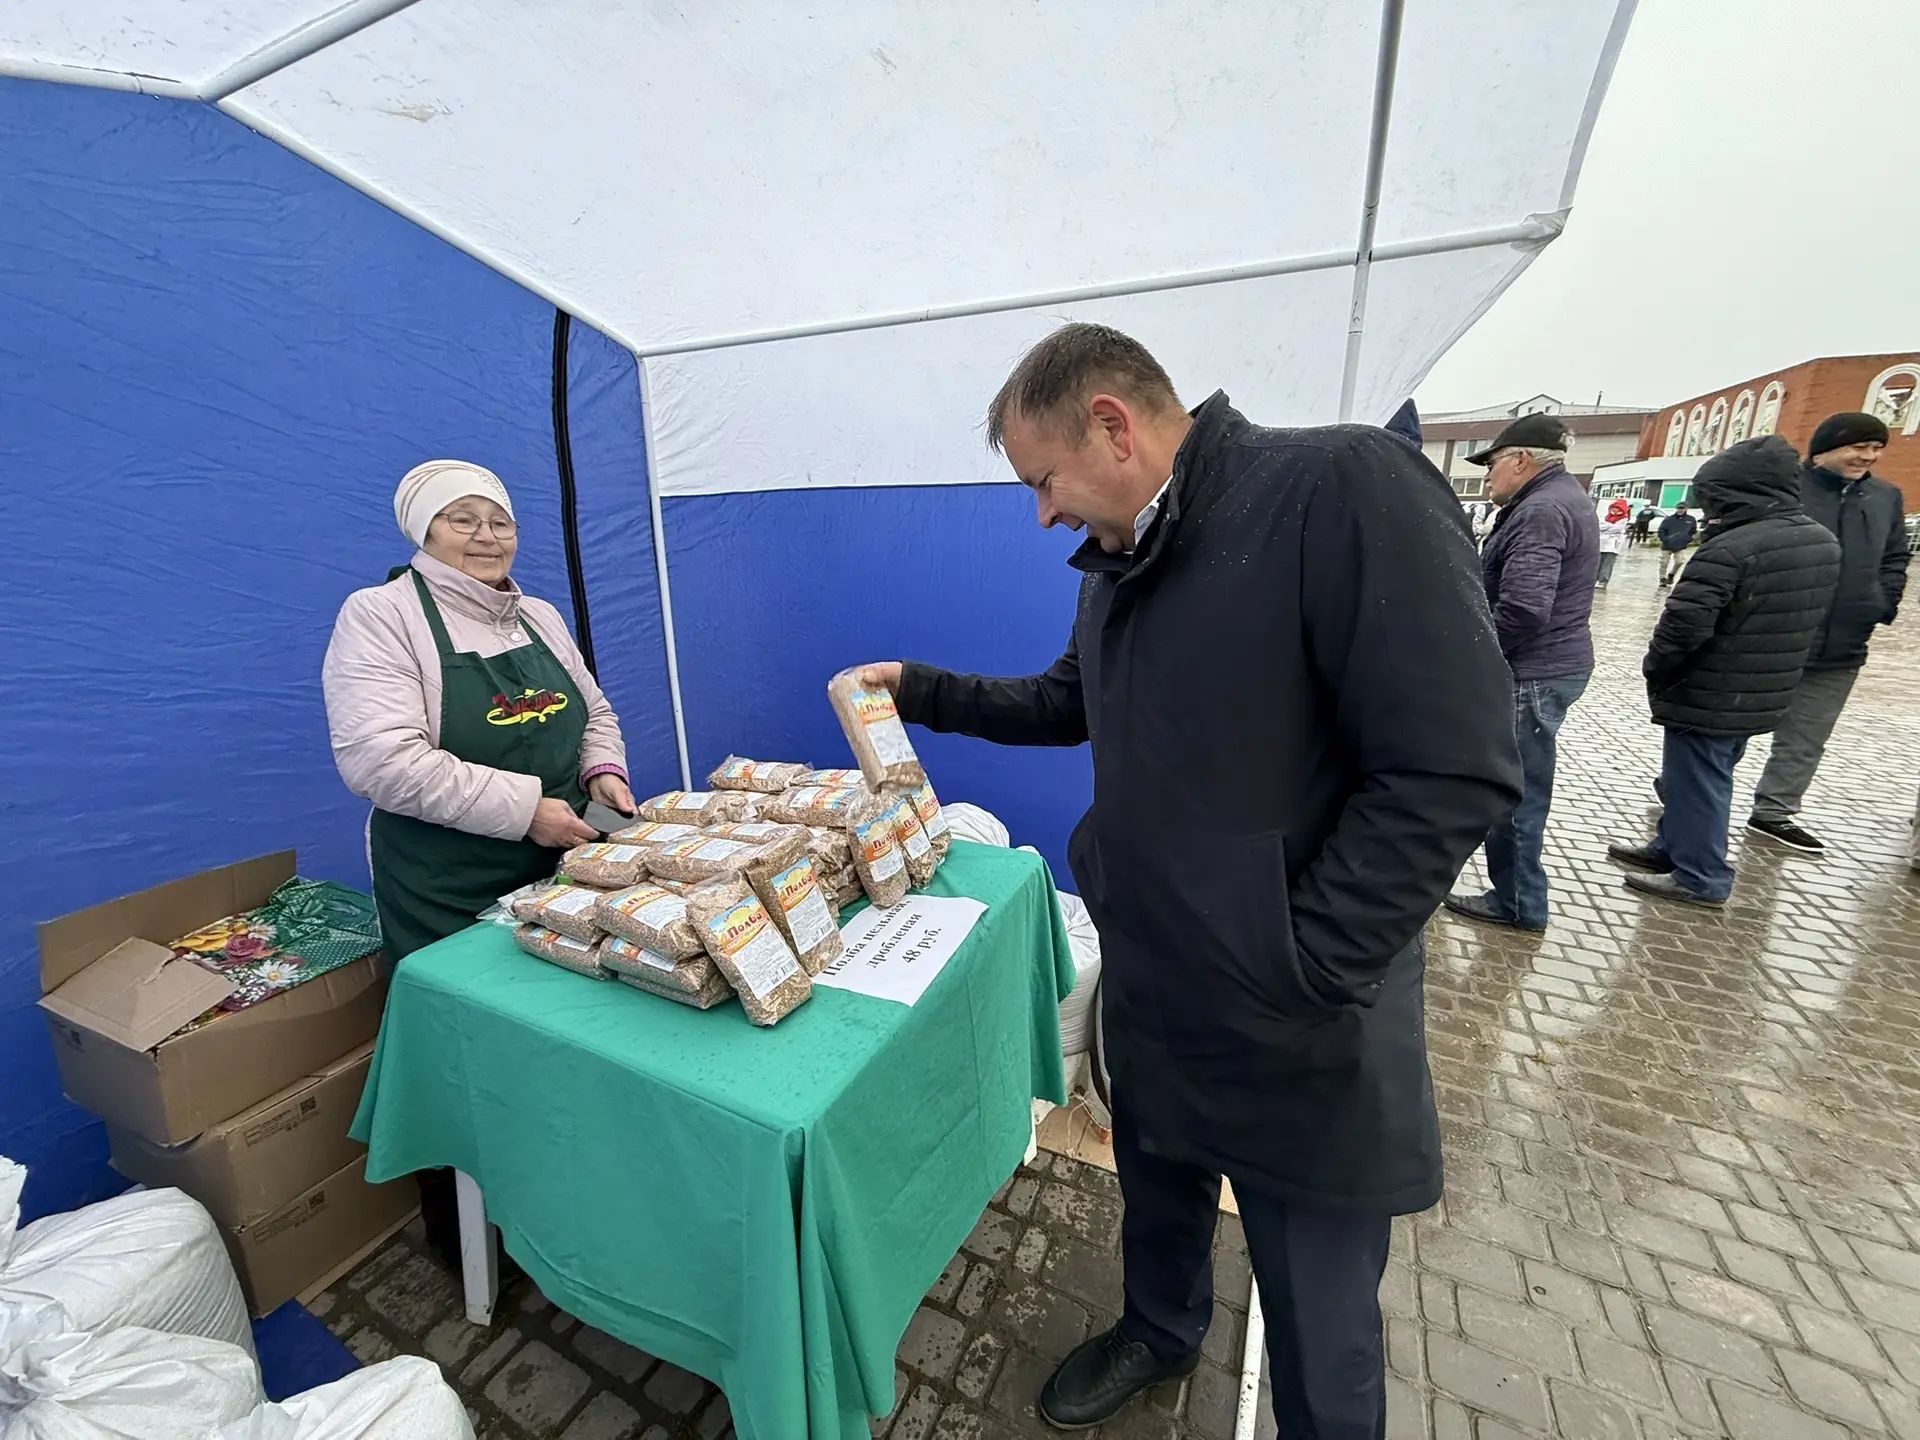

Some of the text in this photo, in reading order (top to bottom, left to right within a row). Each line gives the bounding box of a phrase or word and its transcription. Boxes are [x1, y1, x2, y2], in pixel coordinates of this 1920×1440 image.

[785, 874, 812, 896] Полба
[726, 912, 763, 939] Полба
[866, 913, 923, 968] дробленая
[822, 940, 867, 976] Полба
[902, 927, 942, 964] 48 руб.
